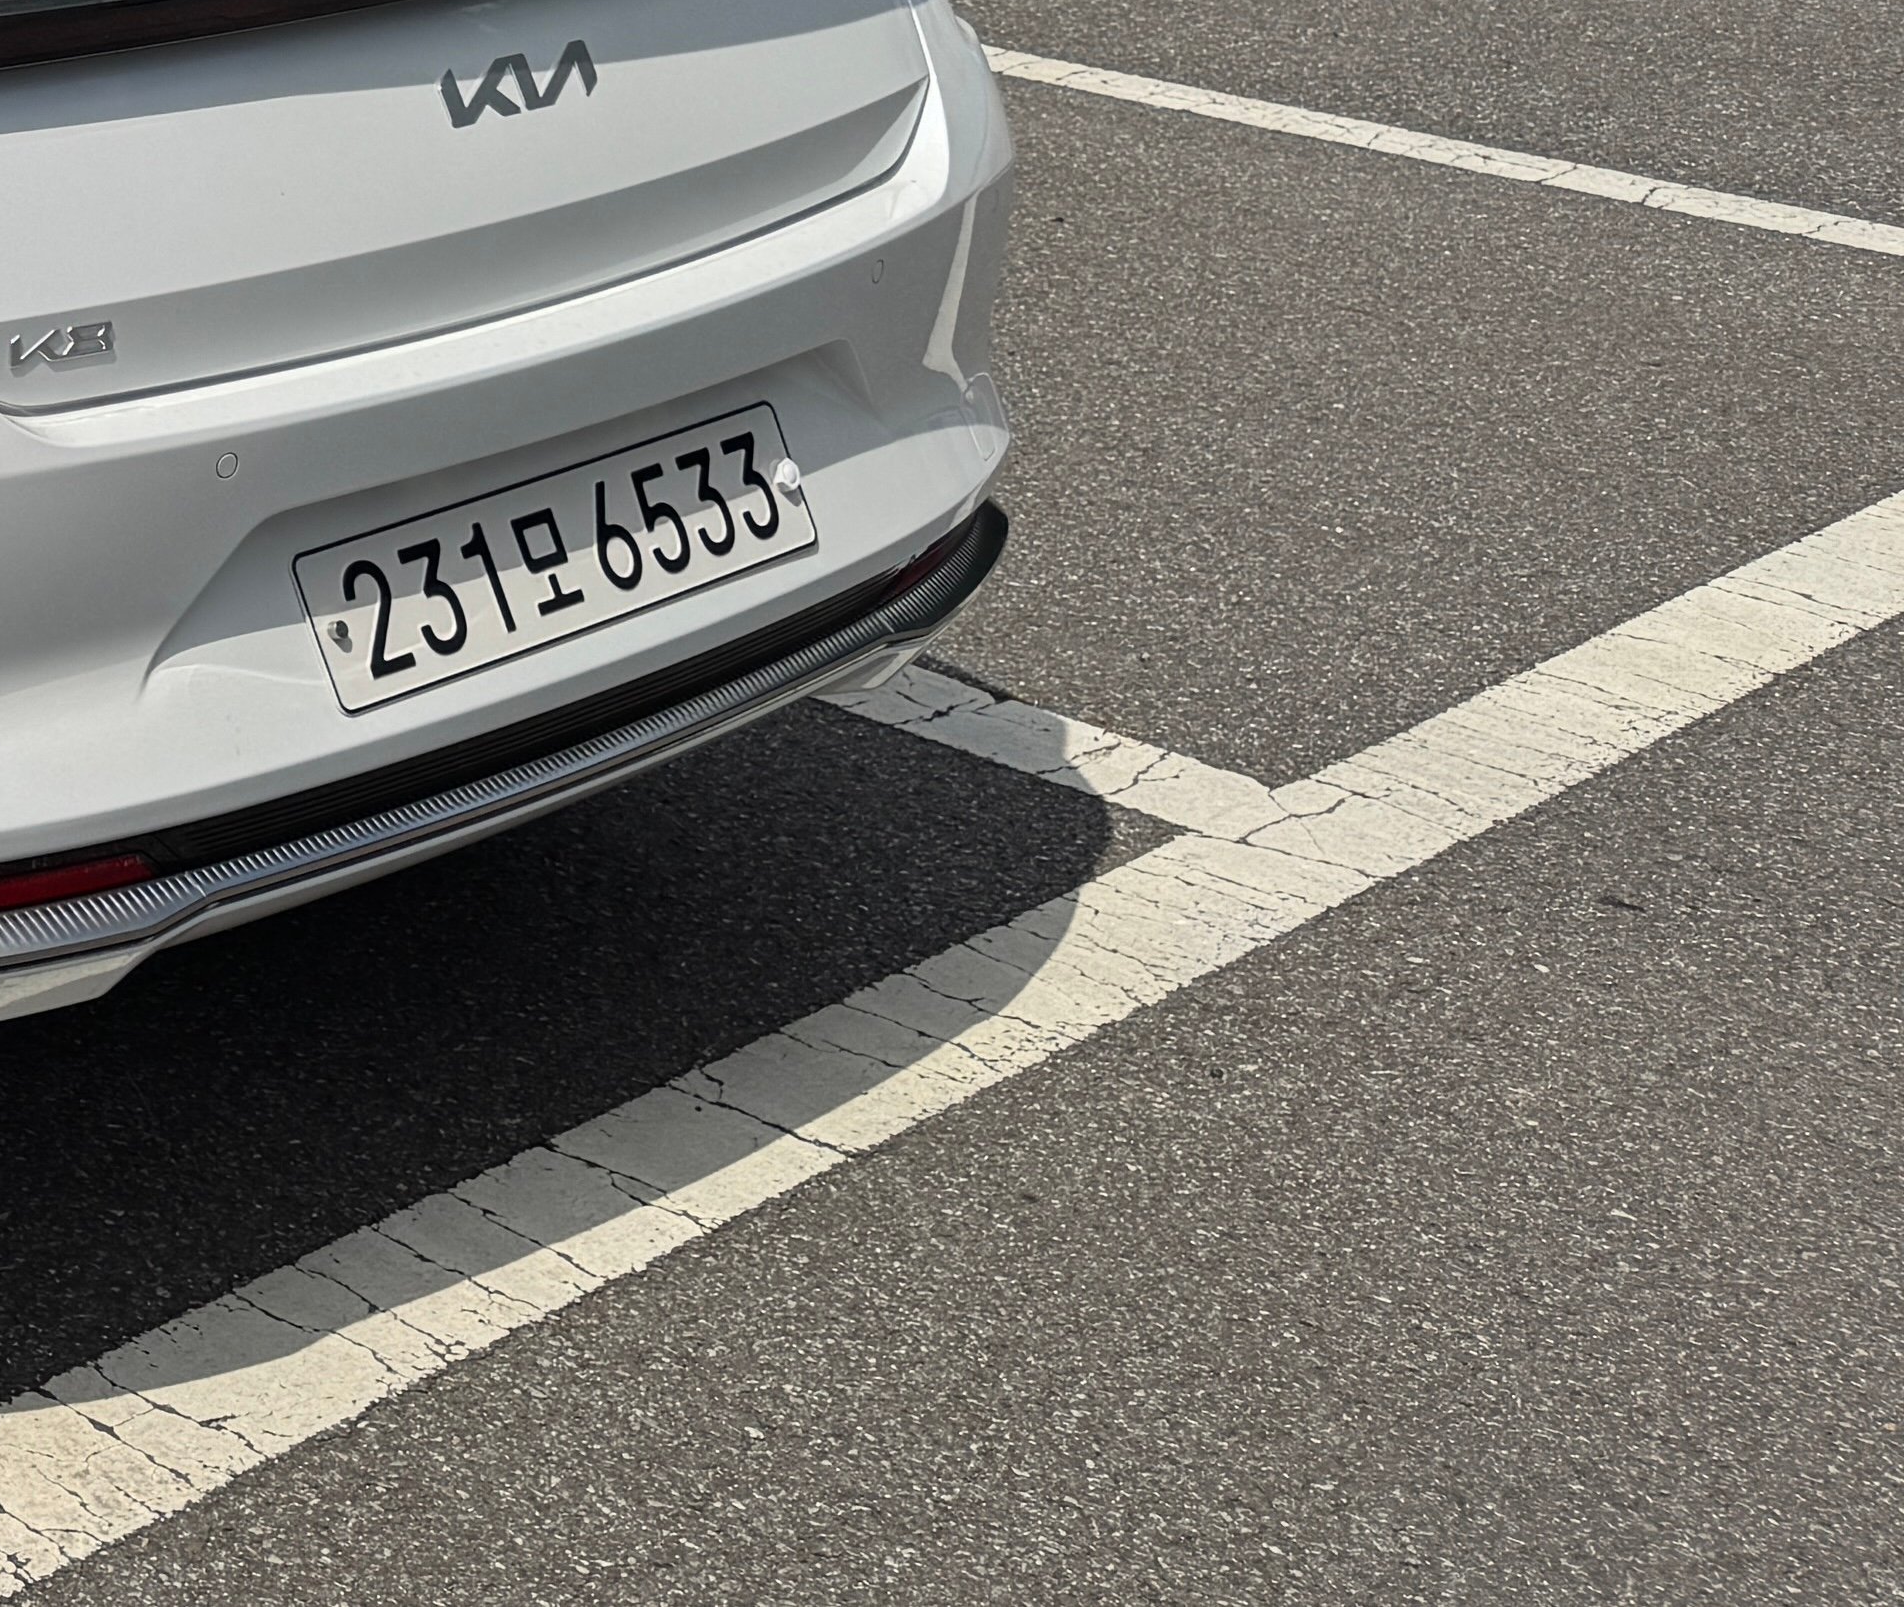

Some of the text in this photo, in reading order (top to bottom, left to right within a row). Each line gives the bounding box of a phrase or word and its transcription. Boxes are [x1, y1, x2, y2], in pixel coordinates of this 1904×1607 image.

[439, 39, 598, 129] KIA
[10, 320, 114, 370] K8
[343, 431, 780, 680] 231모 6533
